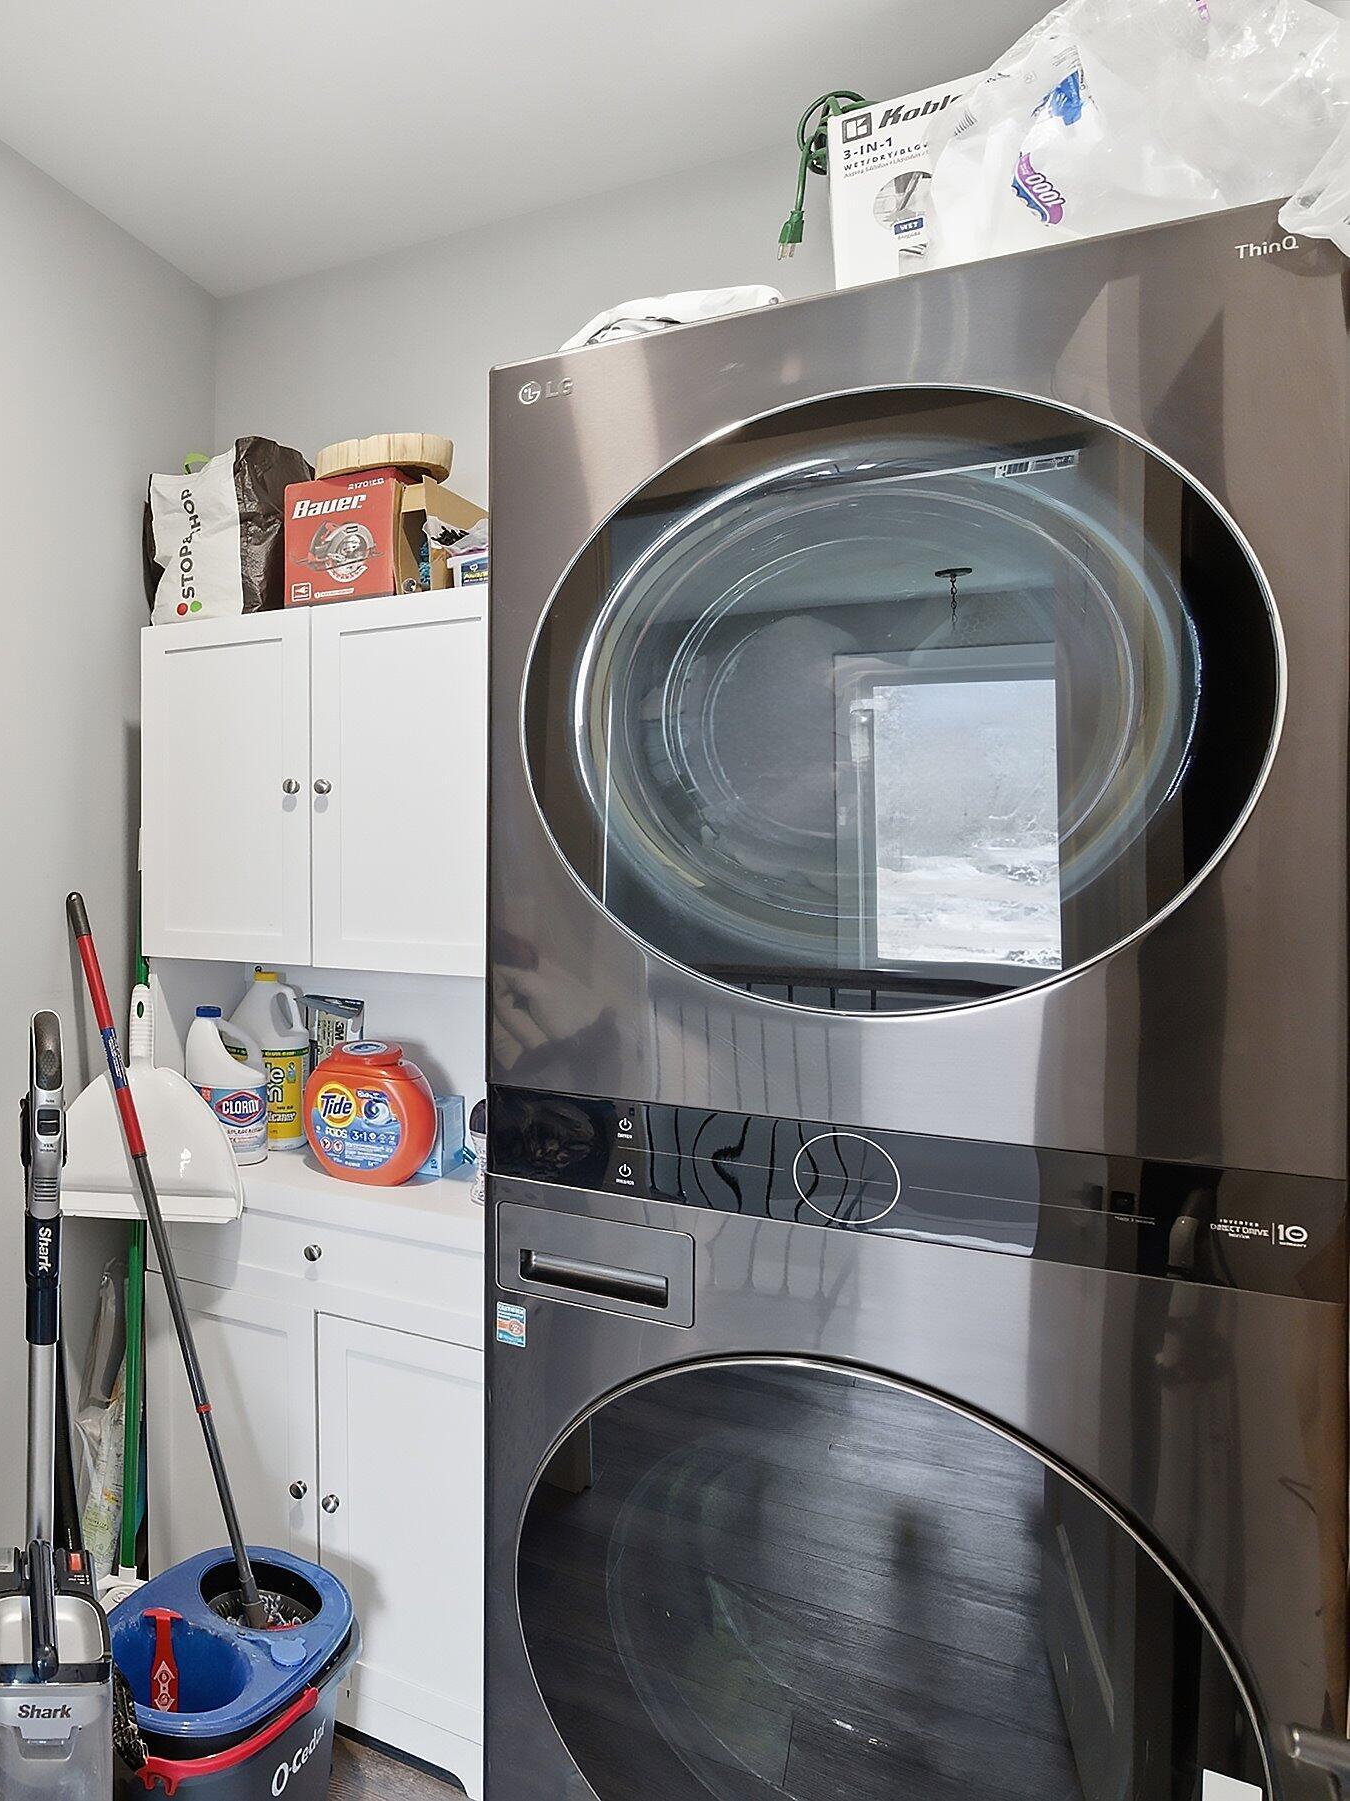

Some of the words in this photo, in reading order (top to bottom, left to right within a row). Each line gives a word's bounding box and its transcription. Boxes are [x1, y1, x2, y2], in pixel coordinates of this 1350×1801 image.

[878, 94, 963, 129] Kobl
[843, 137, 892, 160] 3-IN-1
[1235, 235, 1299, 259] ThinQ
[545, 377, 574, 399] LG
[292, 494, 367, 520] Bauer
[334, 1021, 345, 1041] 3M
[321, 1094, 353, 1118] Tide
[38, 1226, 52, 1273] Shark
[17, 1704, 72, 1719] Shark
[271, 1718, 326, 1797] O-Cedar
